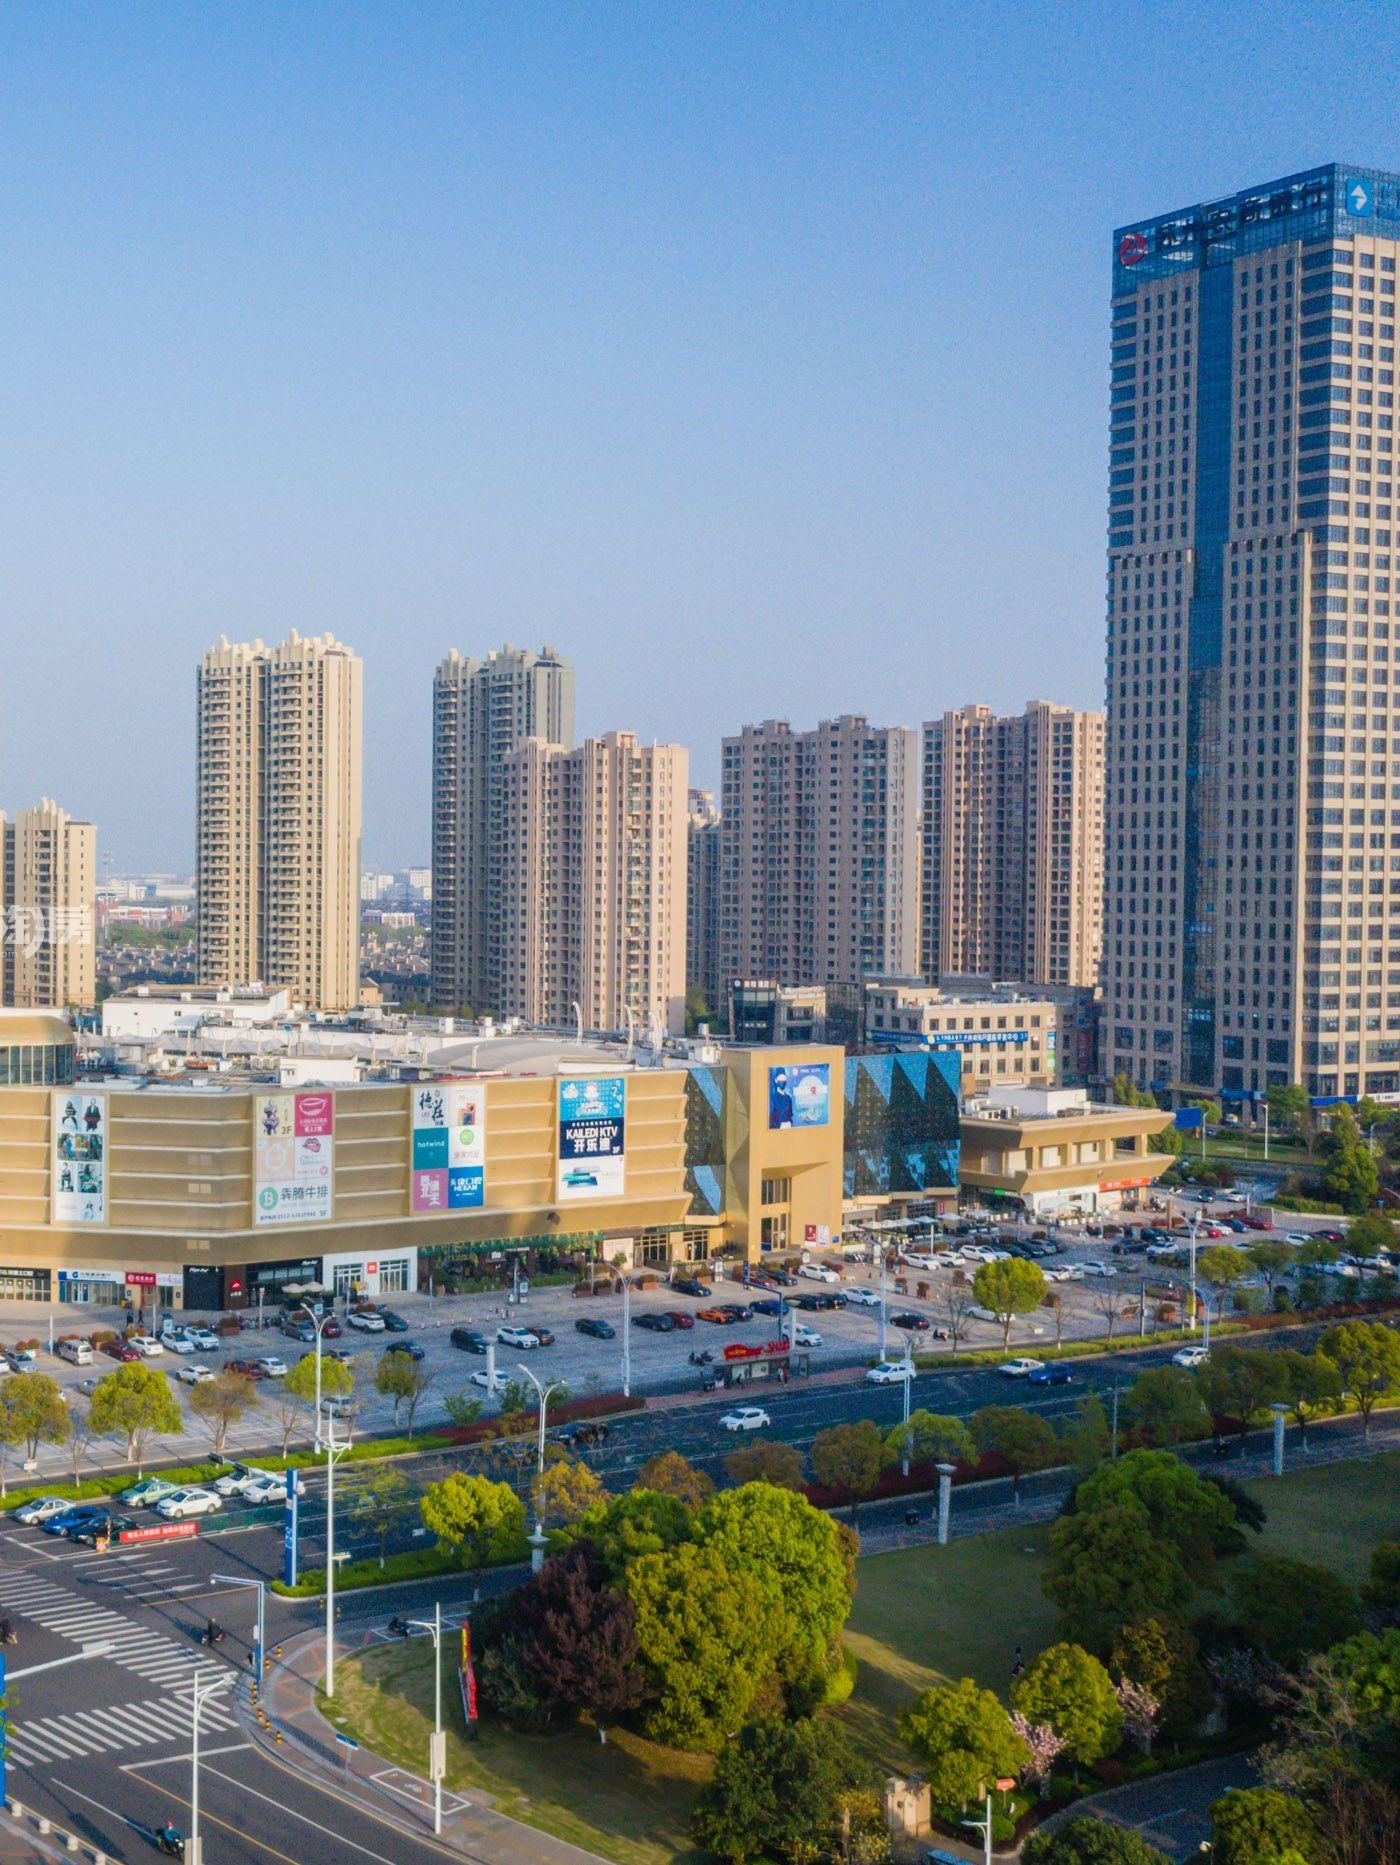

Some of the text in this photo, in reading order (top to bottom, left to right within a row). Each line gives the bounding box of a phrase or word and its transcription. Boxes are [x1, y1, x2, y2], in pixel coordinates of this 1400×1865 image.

[566, 1126, 618, 1139] KAILEDI KTV
[574, 1137, 611, 1152] 开乐迪
